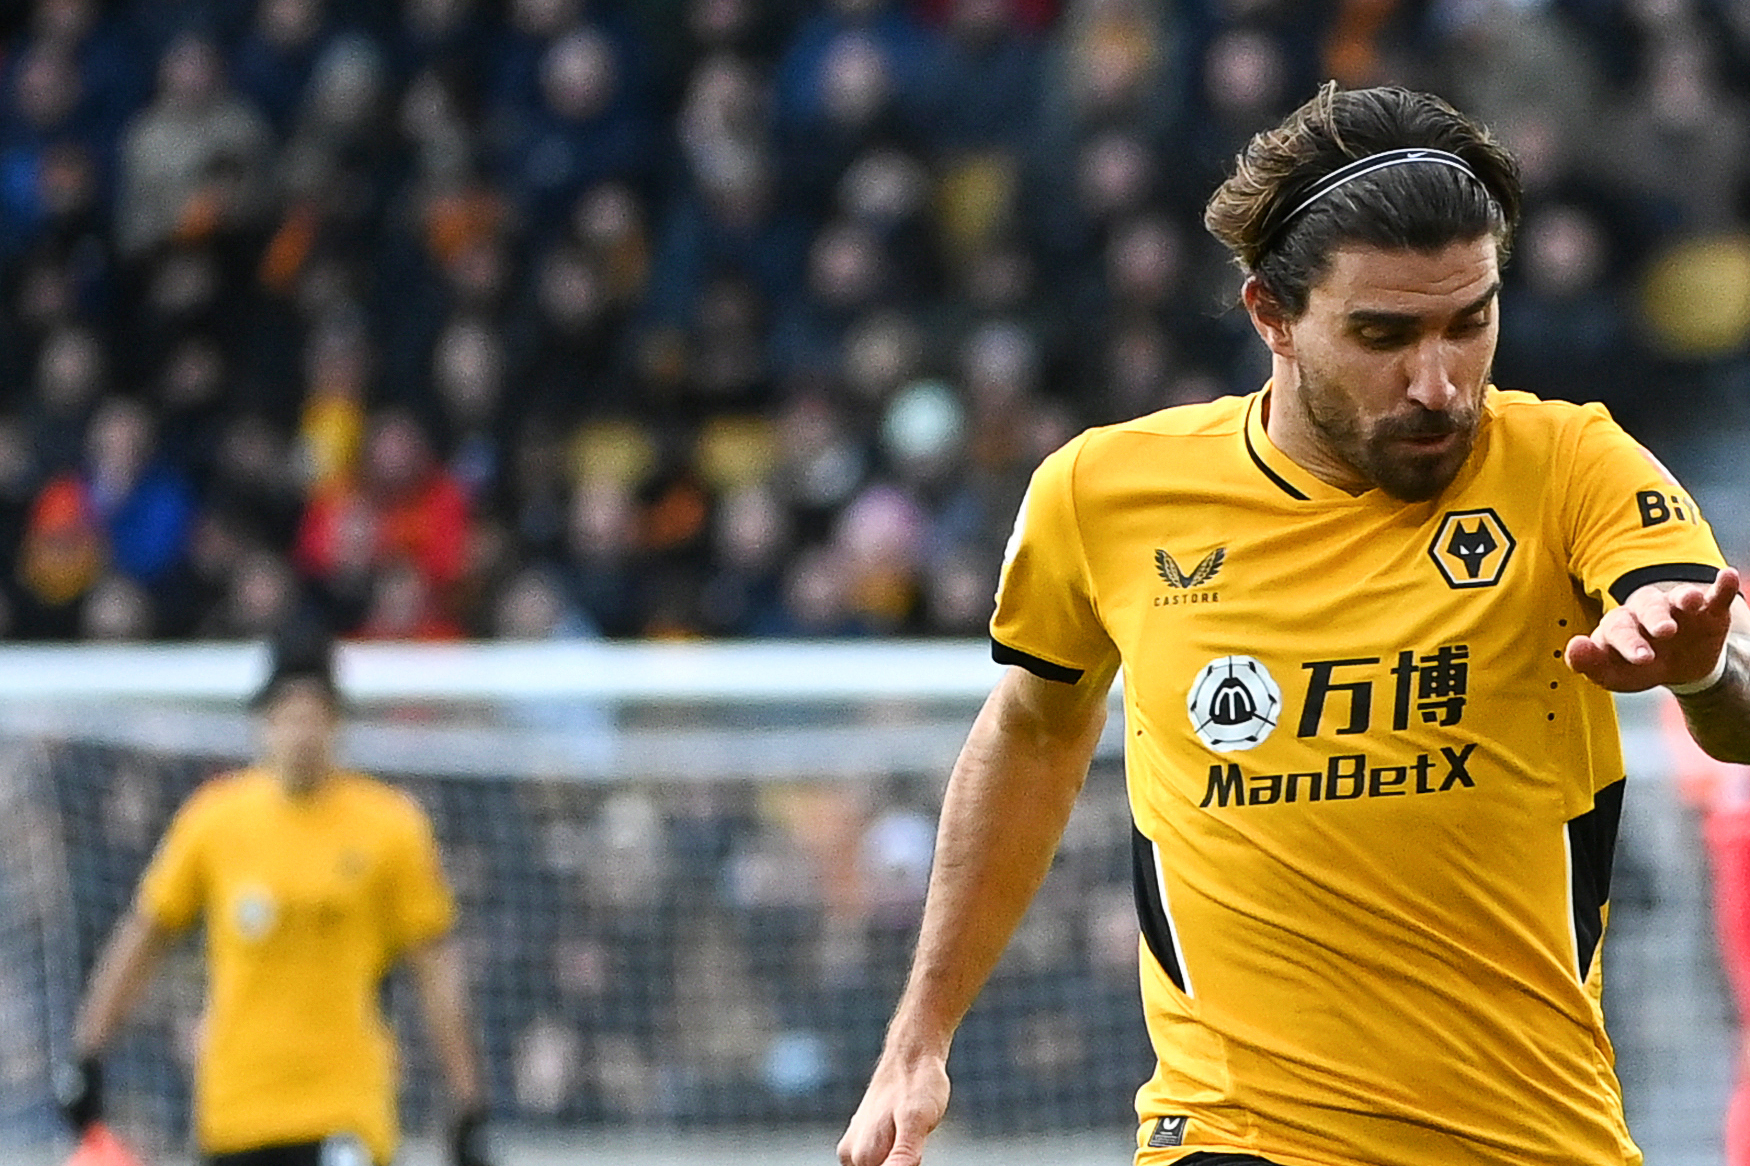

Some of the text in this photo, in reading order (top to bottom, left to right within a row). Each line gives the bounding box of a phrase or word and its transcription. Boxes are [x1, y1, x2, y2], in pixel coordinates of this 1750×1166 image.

[1153, 592, 1219, 607] CASTORE
[1296, 644, 1470, 738] 万博
[1199, 743, 1479, 808] ManBetX
